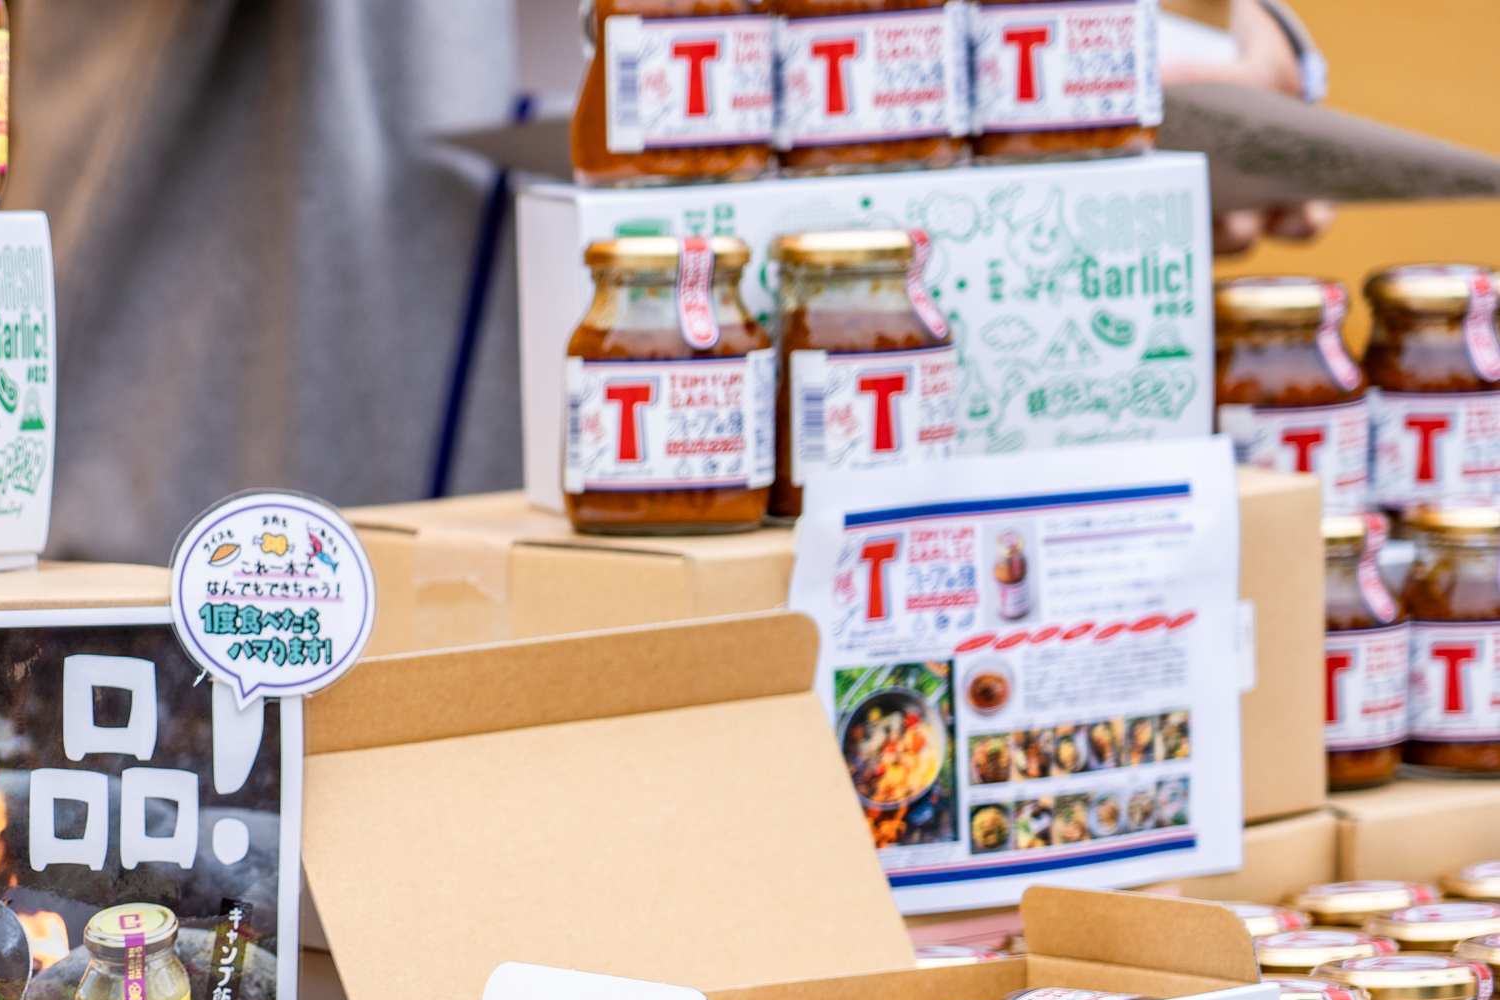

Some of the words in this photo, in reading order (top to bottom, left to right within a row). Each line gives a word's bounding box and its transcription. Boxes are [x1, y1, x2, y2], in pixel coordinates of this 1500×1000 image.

[670, 34, 725, 118] T
[810, 32, 864, 117] T
[1003, 20, 1056, 102] T
[1080, 254, 1194, 300] Garlic!
[605, 375, 660, 463] T
[856, 365, 914, 453] T
[1405, 412, 1452, 484] T
[207, 581, 341, 599] なんでもできちゃう!
[241, 560, 315, 577] これ一本で
[859, 533, 903, 622] T
[198, 602, 321, 635] 1度食べたら
[227, 637, 332, 667] ハマります!
[1431, 642, 1479, 716] T
